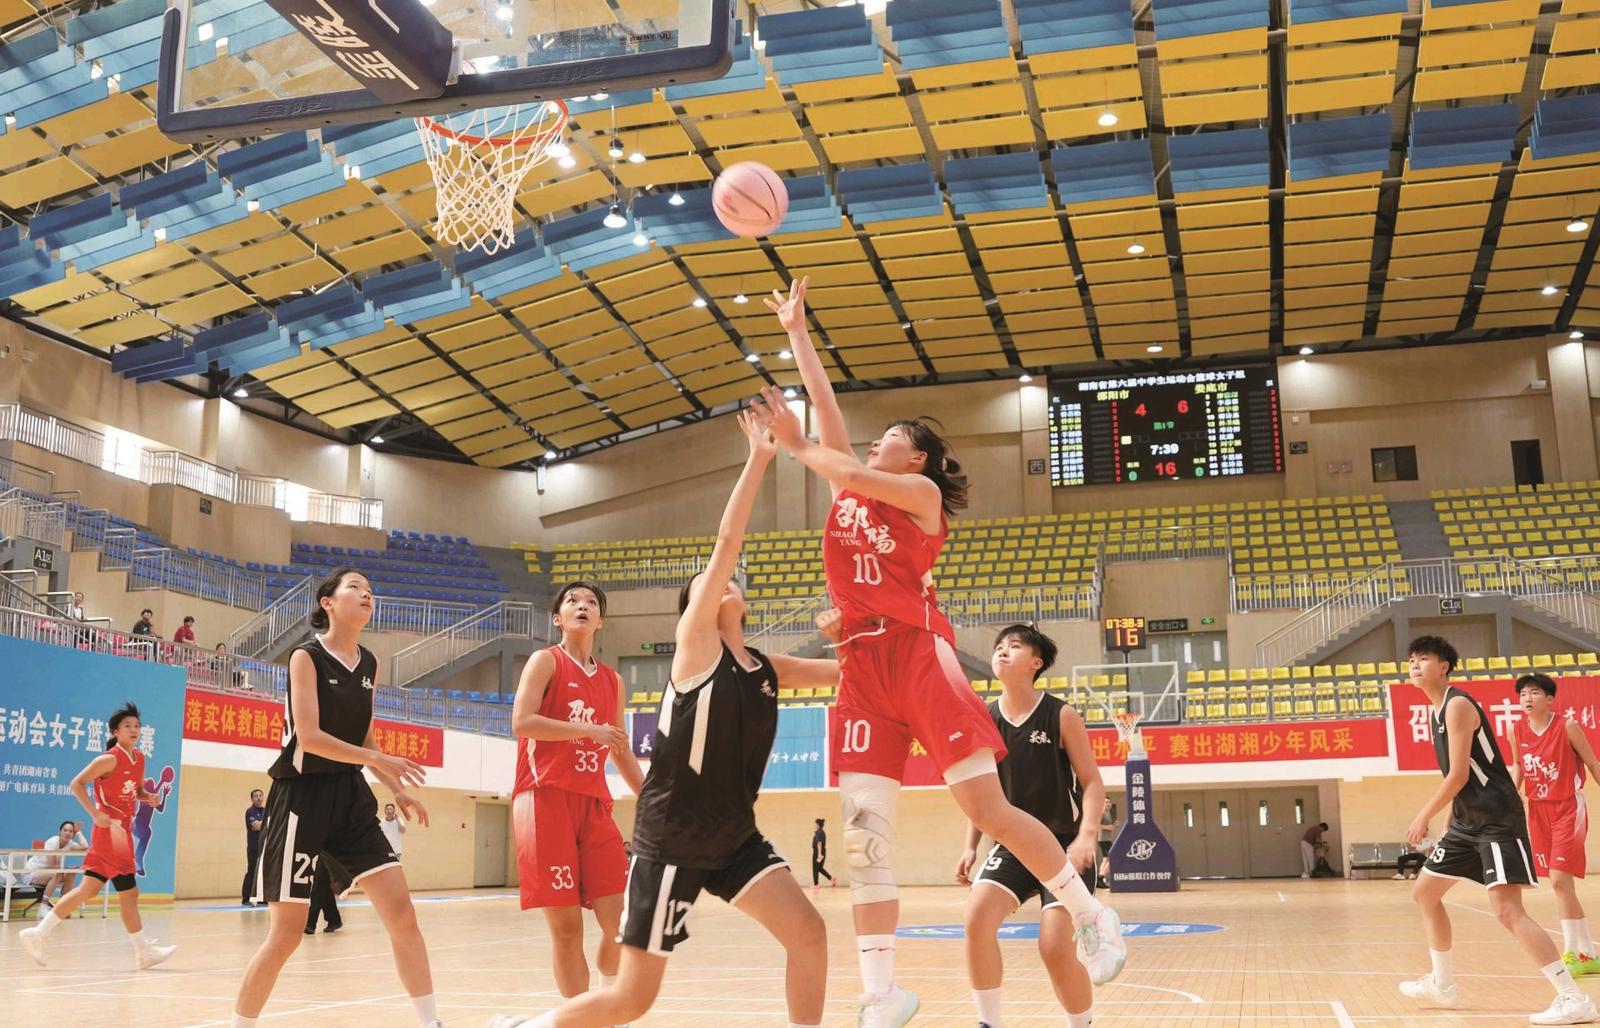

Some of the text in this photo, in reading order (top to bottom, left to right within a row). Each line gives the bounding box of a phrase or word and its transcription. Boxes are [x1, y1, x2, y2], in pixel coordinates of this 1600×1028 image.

[1135, 404, 1147, 416] 4
[1177, 400, 1189, 414] 6
[1150, 443, 1179, 455] 7:39
[1155, 462, 1176, 475] 16
[852, 553, 882, 585] 10
[1106, 618, 1144, 629] 07:38.3
[1115, 628, 1138, 646] 16
[186, 699, 284, 743] 落实体教融合
[842, 719, 871, 753] 10
[1169, 727, 1354, 757] 赛出湖湘少年风采
[575, 749, 599, 773] 33
[550, 865, 574, 890] 33
